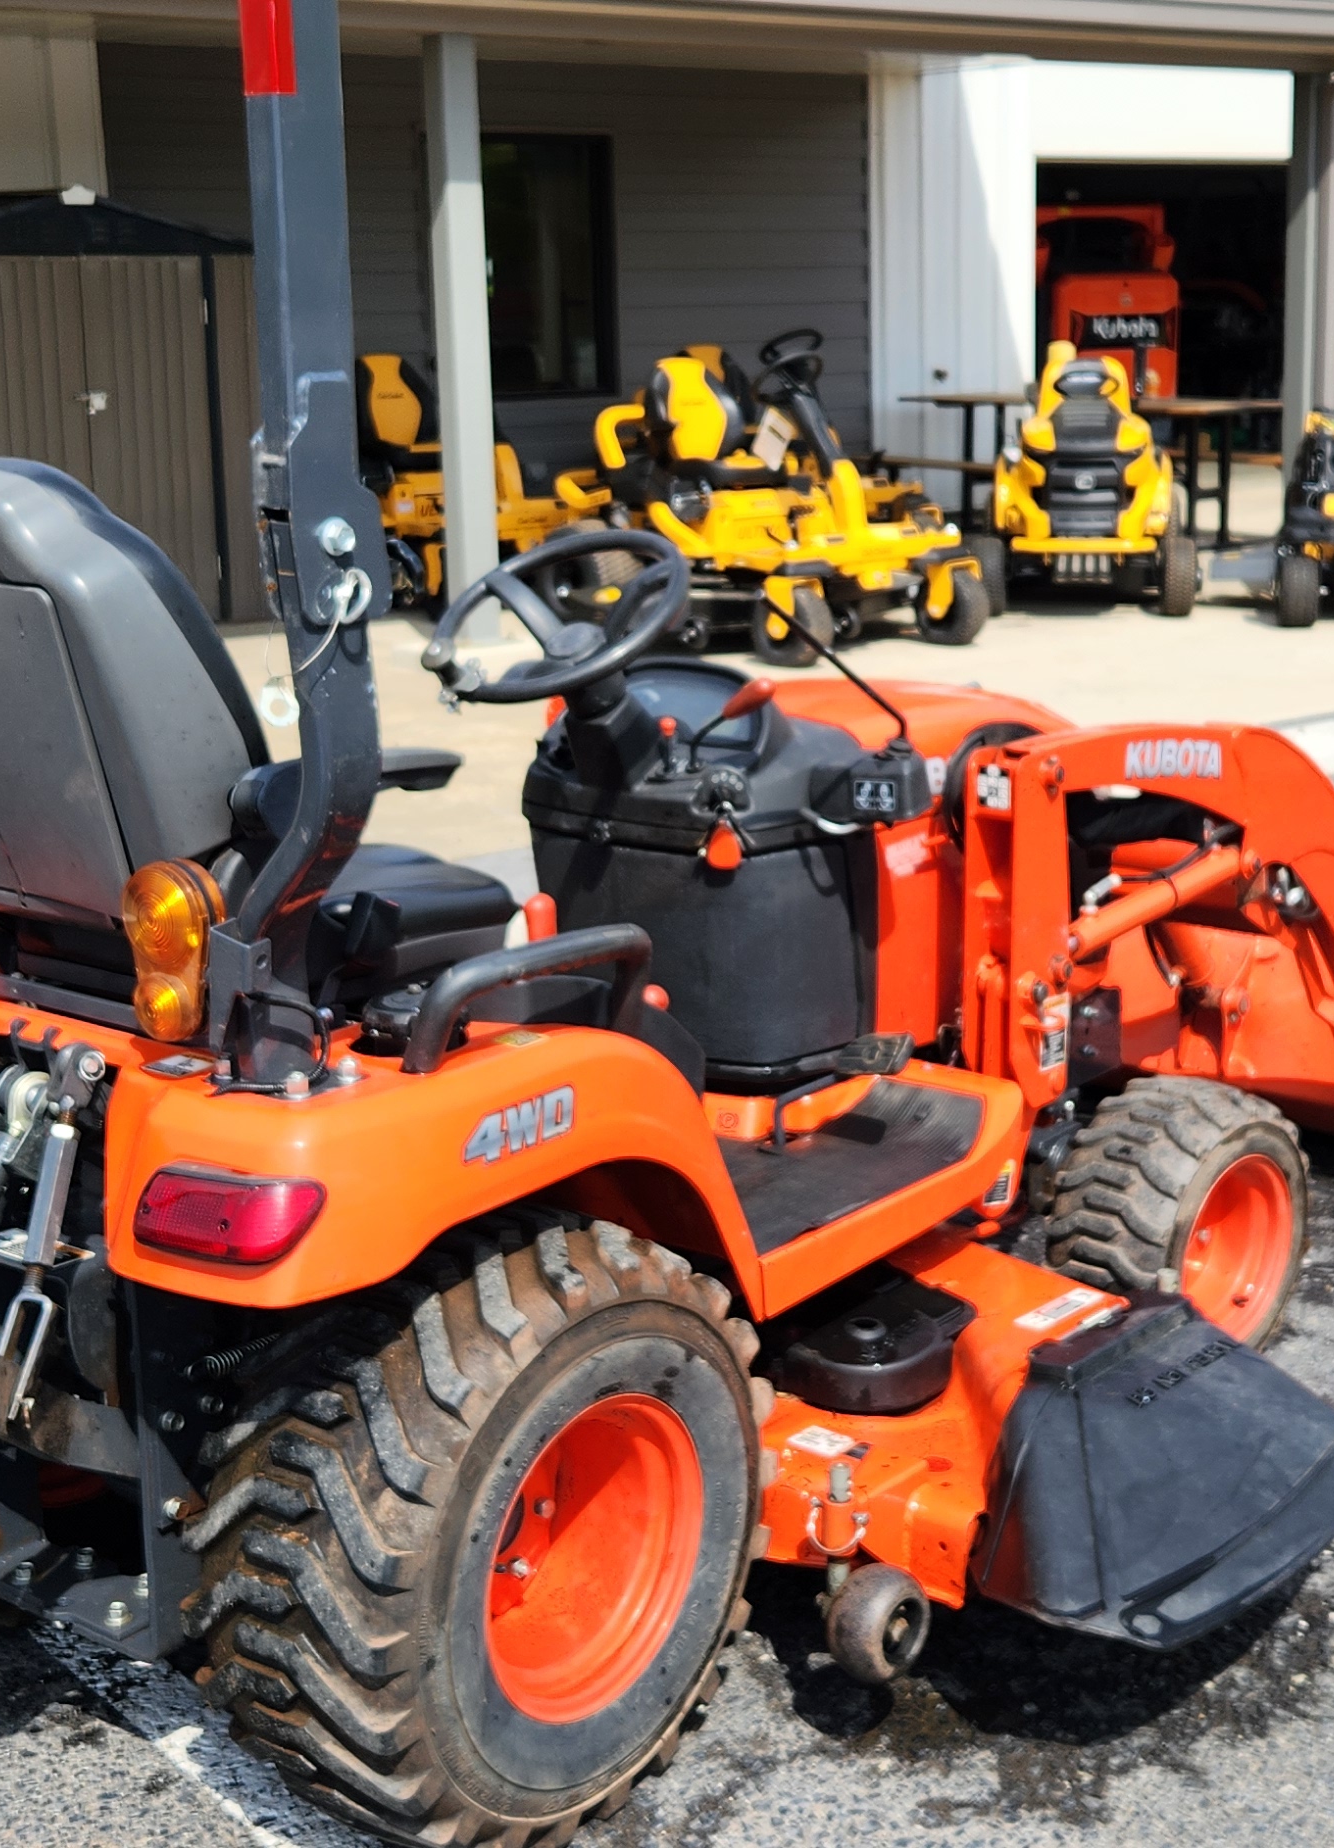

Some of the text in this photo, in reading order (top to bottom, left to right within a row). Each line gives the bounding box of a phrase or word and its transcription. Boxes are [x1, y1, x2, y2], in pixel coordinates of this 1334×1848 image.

[1093, 315, 1159, 339] Kubota
[1125, 738, 1221, 780] KUBOTA
[464, 1084, 575, 1163] 4WD
